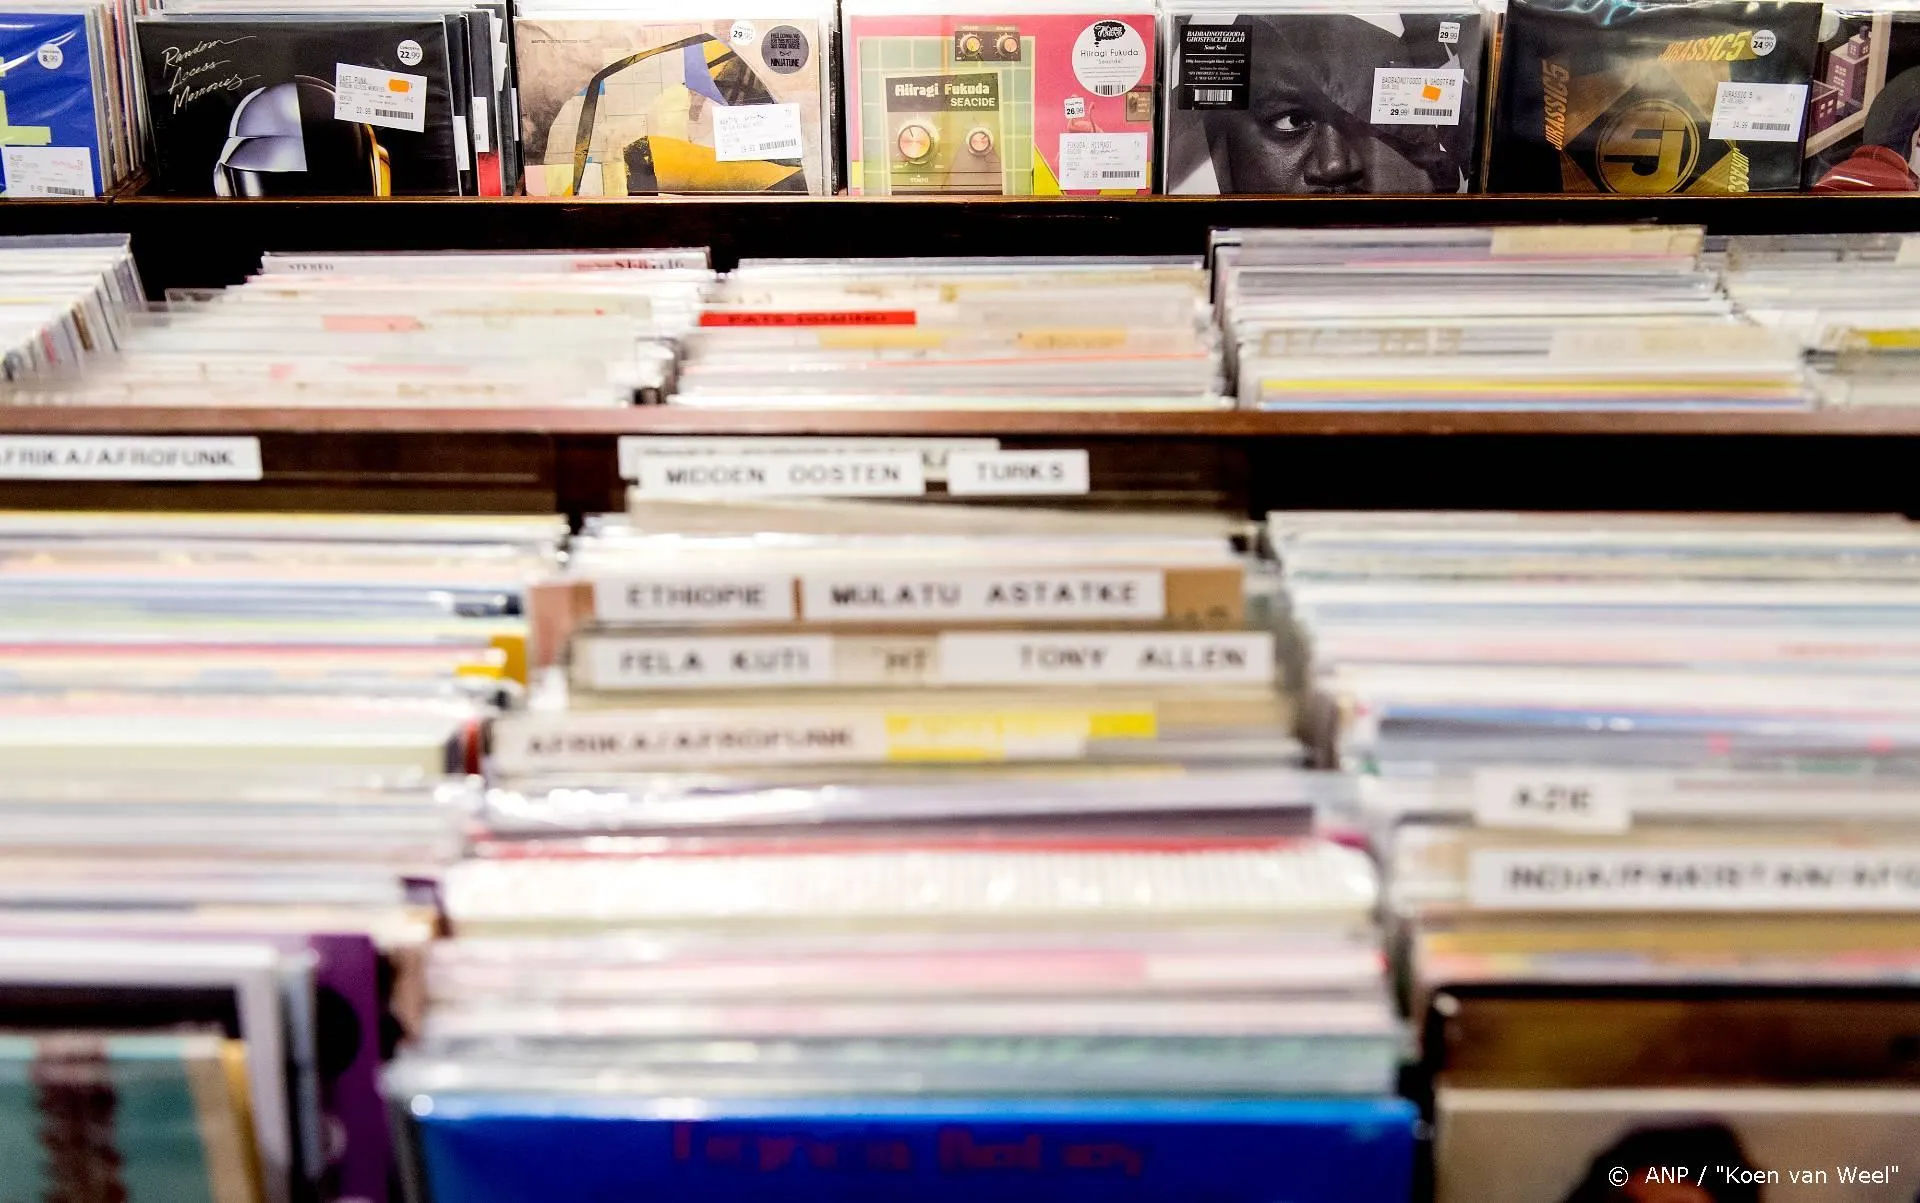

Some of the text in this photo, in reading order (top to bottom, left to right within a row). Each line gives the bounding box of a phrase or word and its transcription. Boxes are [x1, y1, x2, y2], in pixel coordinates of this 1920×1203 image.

[162, 36, 256, 78] Random
[168, 60, 231, 95] Access
[944, 83, 990, 94] Fukuda
[173, 74, 261, 114] Memories
[951, 98, 995, 106] SEACIDE
[831, 582, 961, 606] MULATU
[989, 580, 1139, 604] ASTATKE
[1019, 646, 1108, 670] TONY
[1138, 644, 1248, 670] ALLEN
